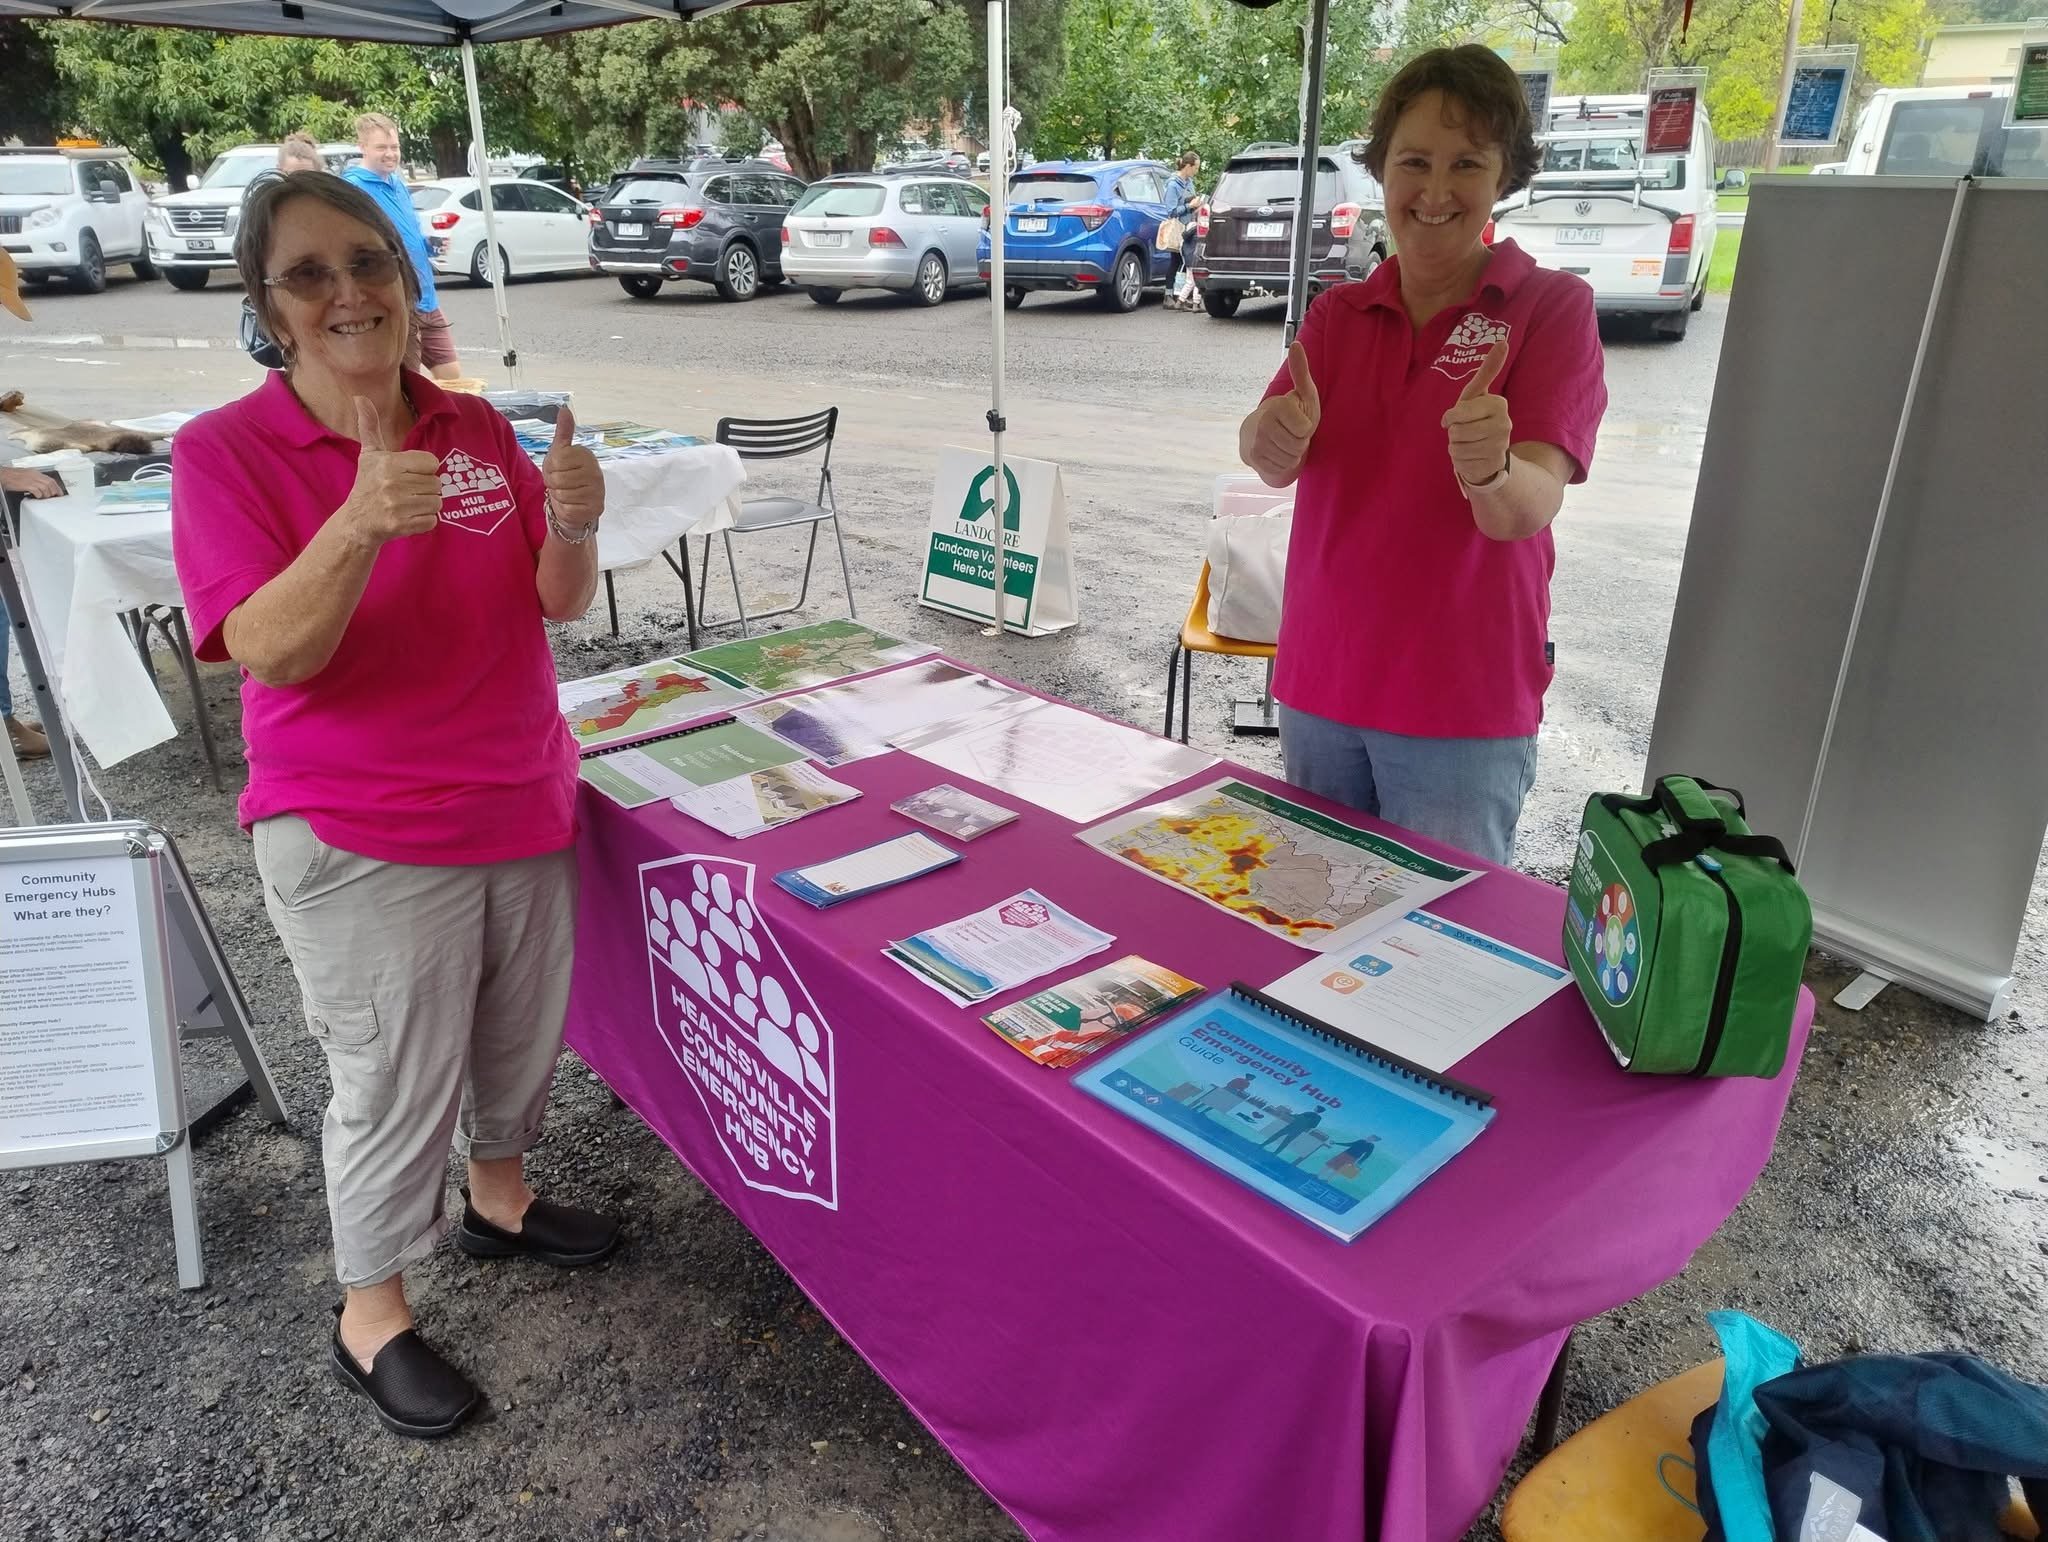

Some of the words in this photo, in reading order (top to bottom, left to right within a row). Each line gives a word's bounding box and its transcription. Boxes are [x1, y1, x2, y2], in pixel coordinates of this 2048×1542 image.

[1433, 353, 1488, 365] OLUNTEE
[1453, 348, 1477, 357] HUB
[443, 499, 511, 520] VOLUNTEER
[461, 495, 486, 507] HUB
[954, 521, 1021, 548] LANDCRE
[934, 538, 980, 560] Landcare
[981, 549, 1034, 574] Vonteers
[953, 559, 976, 576] Here
[1300, 817, 1353, 840] Catastrophic
[1354, 838, 1372, 848] Fire
[1372, 843, 1408, 864] Danger
[1408, 861, 1428, 873] Day
[21, 871, 97, 886] Community
[5, 890, 79, 903] Emergency
[82, 887, 117, 898] Hubs
[13, 910, 48, 921] What
[51, 910, 72, 919] are
[75, 904, 112, 918] they?
[1353, 962, 1379, 977] BOM
[671, 984, 817, 1141] HEALESVILLE
[1178, 1036, 1225, 1065] Guide
[1205, 1021, 1312, 1078] Community
[1191, 1027, 1298, 1086] Emergency
[1299, 1082, 1342, 1109] Hub
[680, 1020, 813, 1158] COMMUNITY
[682, 1044, 816, 1187] EMERGENCY
[725, 1112, 770, 1171] HUB
